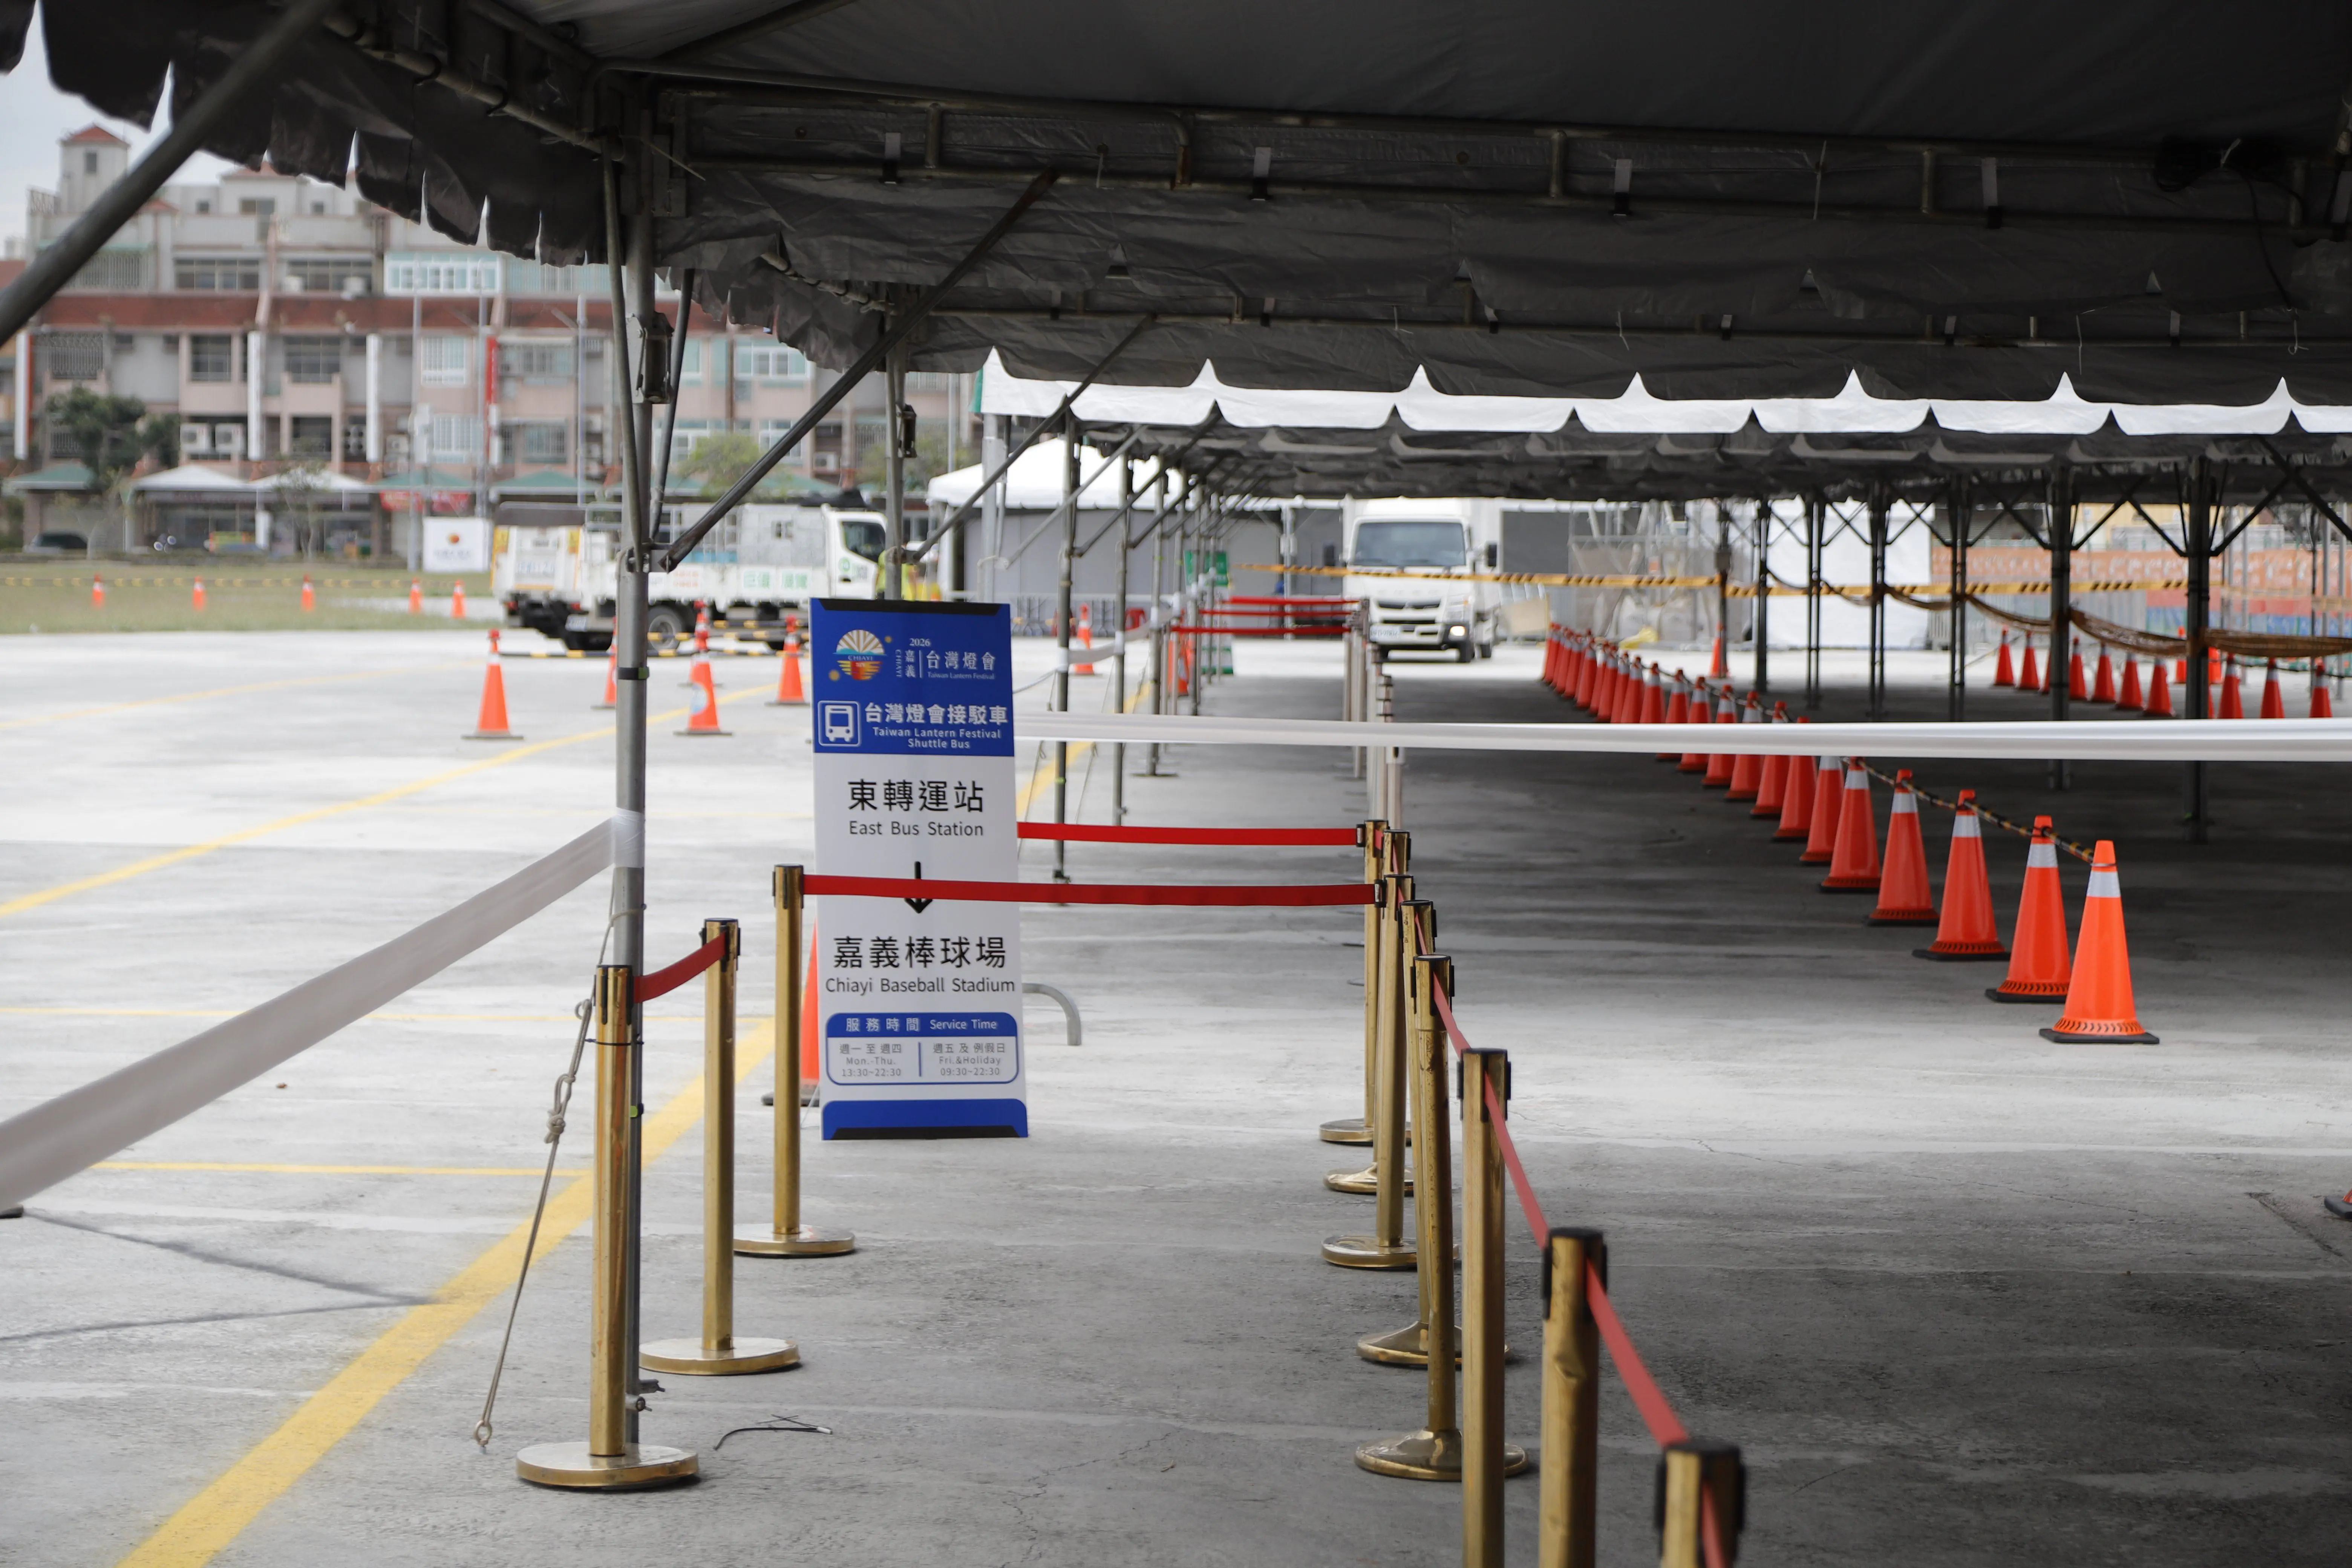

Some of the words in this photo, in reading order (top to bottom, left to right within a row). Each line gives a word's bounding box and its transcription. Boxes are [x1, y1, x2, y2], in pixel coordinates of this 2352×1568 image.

[910, 638, 931, 646] 2026
[905, 650, 915, 677] 嘉義
[926, 650, 995, 671] 台灣燈會
[865, 702, 1007, 725] 台灣燈會接駁車
[872, 727, 910, 737] Taiwan
[914, 728, 956, 738] Lantern
[959, 729, 1001, 739] Festival
[908, 738, 947, 748] Shuttle
[951, 739, 970, 748] Bus
[848, 779, 983, 812] 東轉運站
[850, 821, 882, 835] East
[891, 821, 919, 835] Bus
[928, 821, 983, 836] Station
[835, 936, 1006, 968] 嘉義棒球場
[826, 977, 872, 996] Chiayi
[881, 977, 945, 992] Baseball
[952, 977, 1015, 992] Stadium
[846, 1018, 919, 1032] 服務時間
[930, 1019, 967, 1029] Service
[971, 1019, 997, 1029] Time
[846, 1057, 896, 1065] Mon.-Thu.
[939, 1056, 1001, 1066] Fri.&Holiday
[842, 1068, 901, 1076] 13:30~22:30
[940, 1067, 1000, 1076] 09:30~22:30
